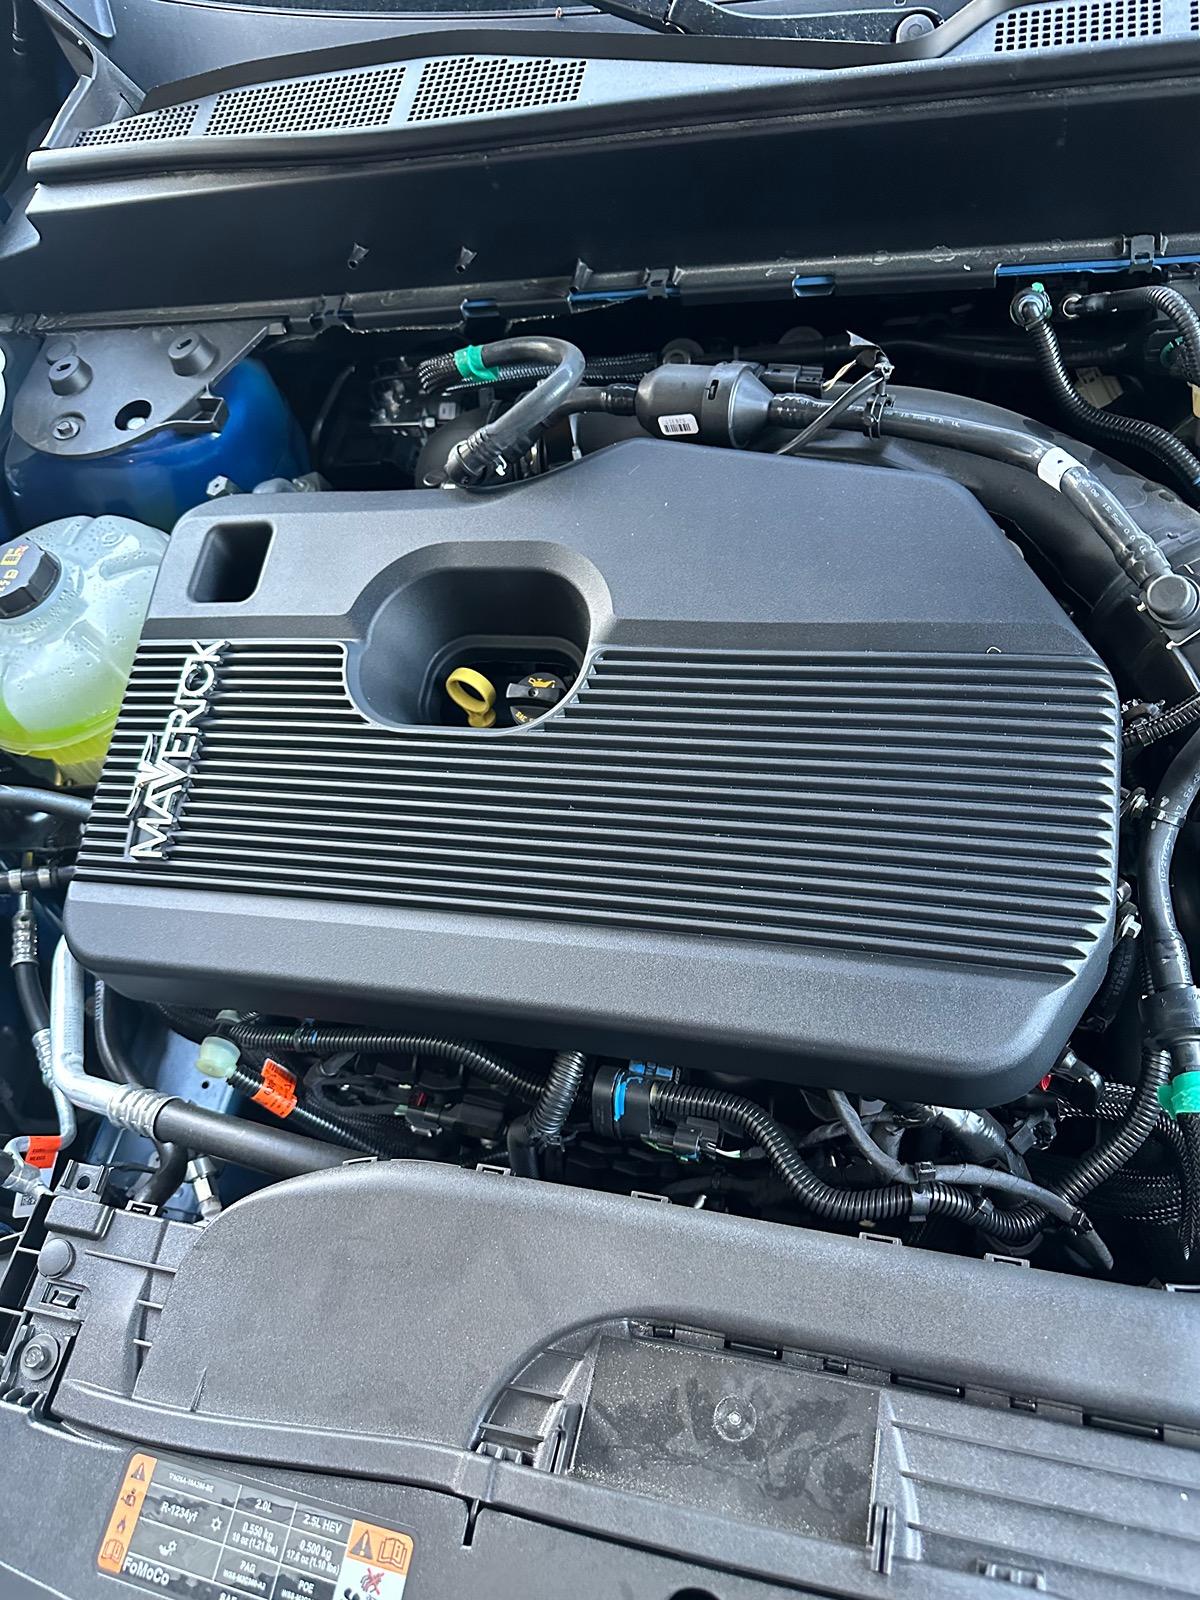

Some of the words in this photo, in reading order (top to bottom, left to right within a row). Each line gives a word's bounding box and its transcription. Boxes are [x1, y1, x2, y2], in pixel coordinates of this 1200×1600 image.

[130, 639, 229, 859] MAVERICK
[160, 1501, 198, 1524] R-1234yf
[254, 1498, 272, 1514] 2.0L
[242, 1521, 263, 1538] 0.550
[263, 1527, 274, 1542] kg
[302, 1513, 321, 1529] 2.5L
[322, 1518, 343, 1535] HEV
[299, 1540, 321, 1556] 0.500
[320, 1546, 333, 1561] kg
[122, 1557, 170, 1586] FoMoCo
[297, 1579, 315, 1594] POE
